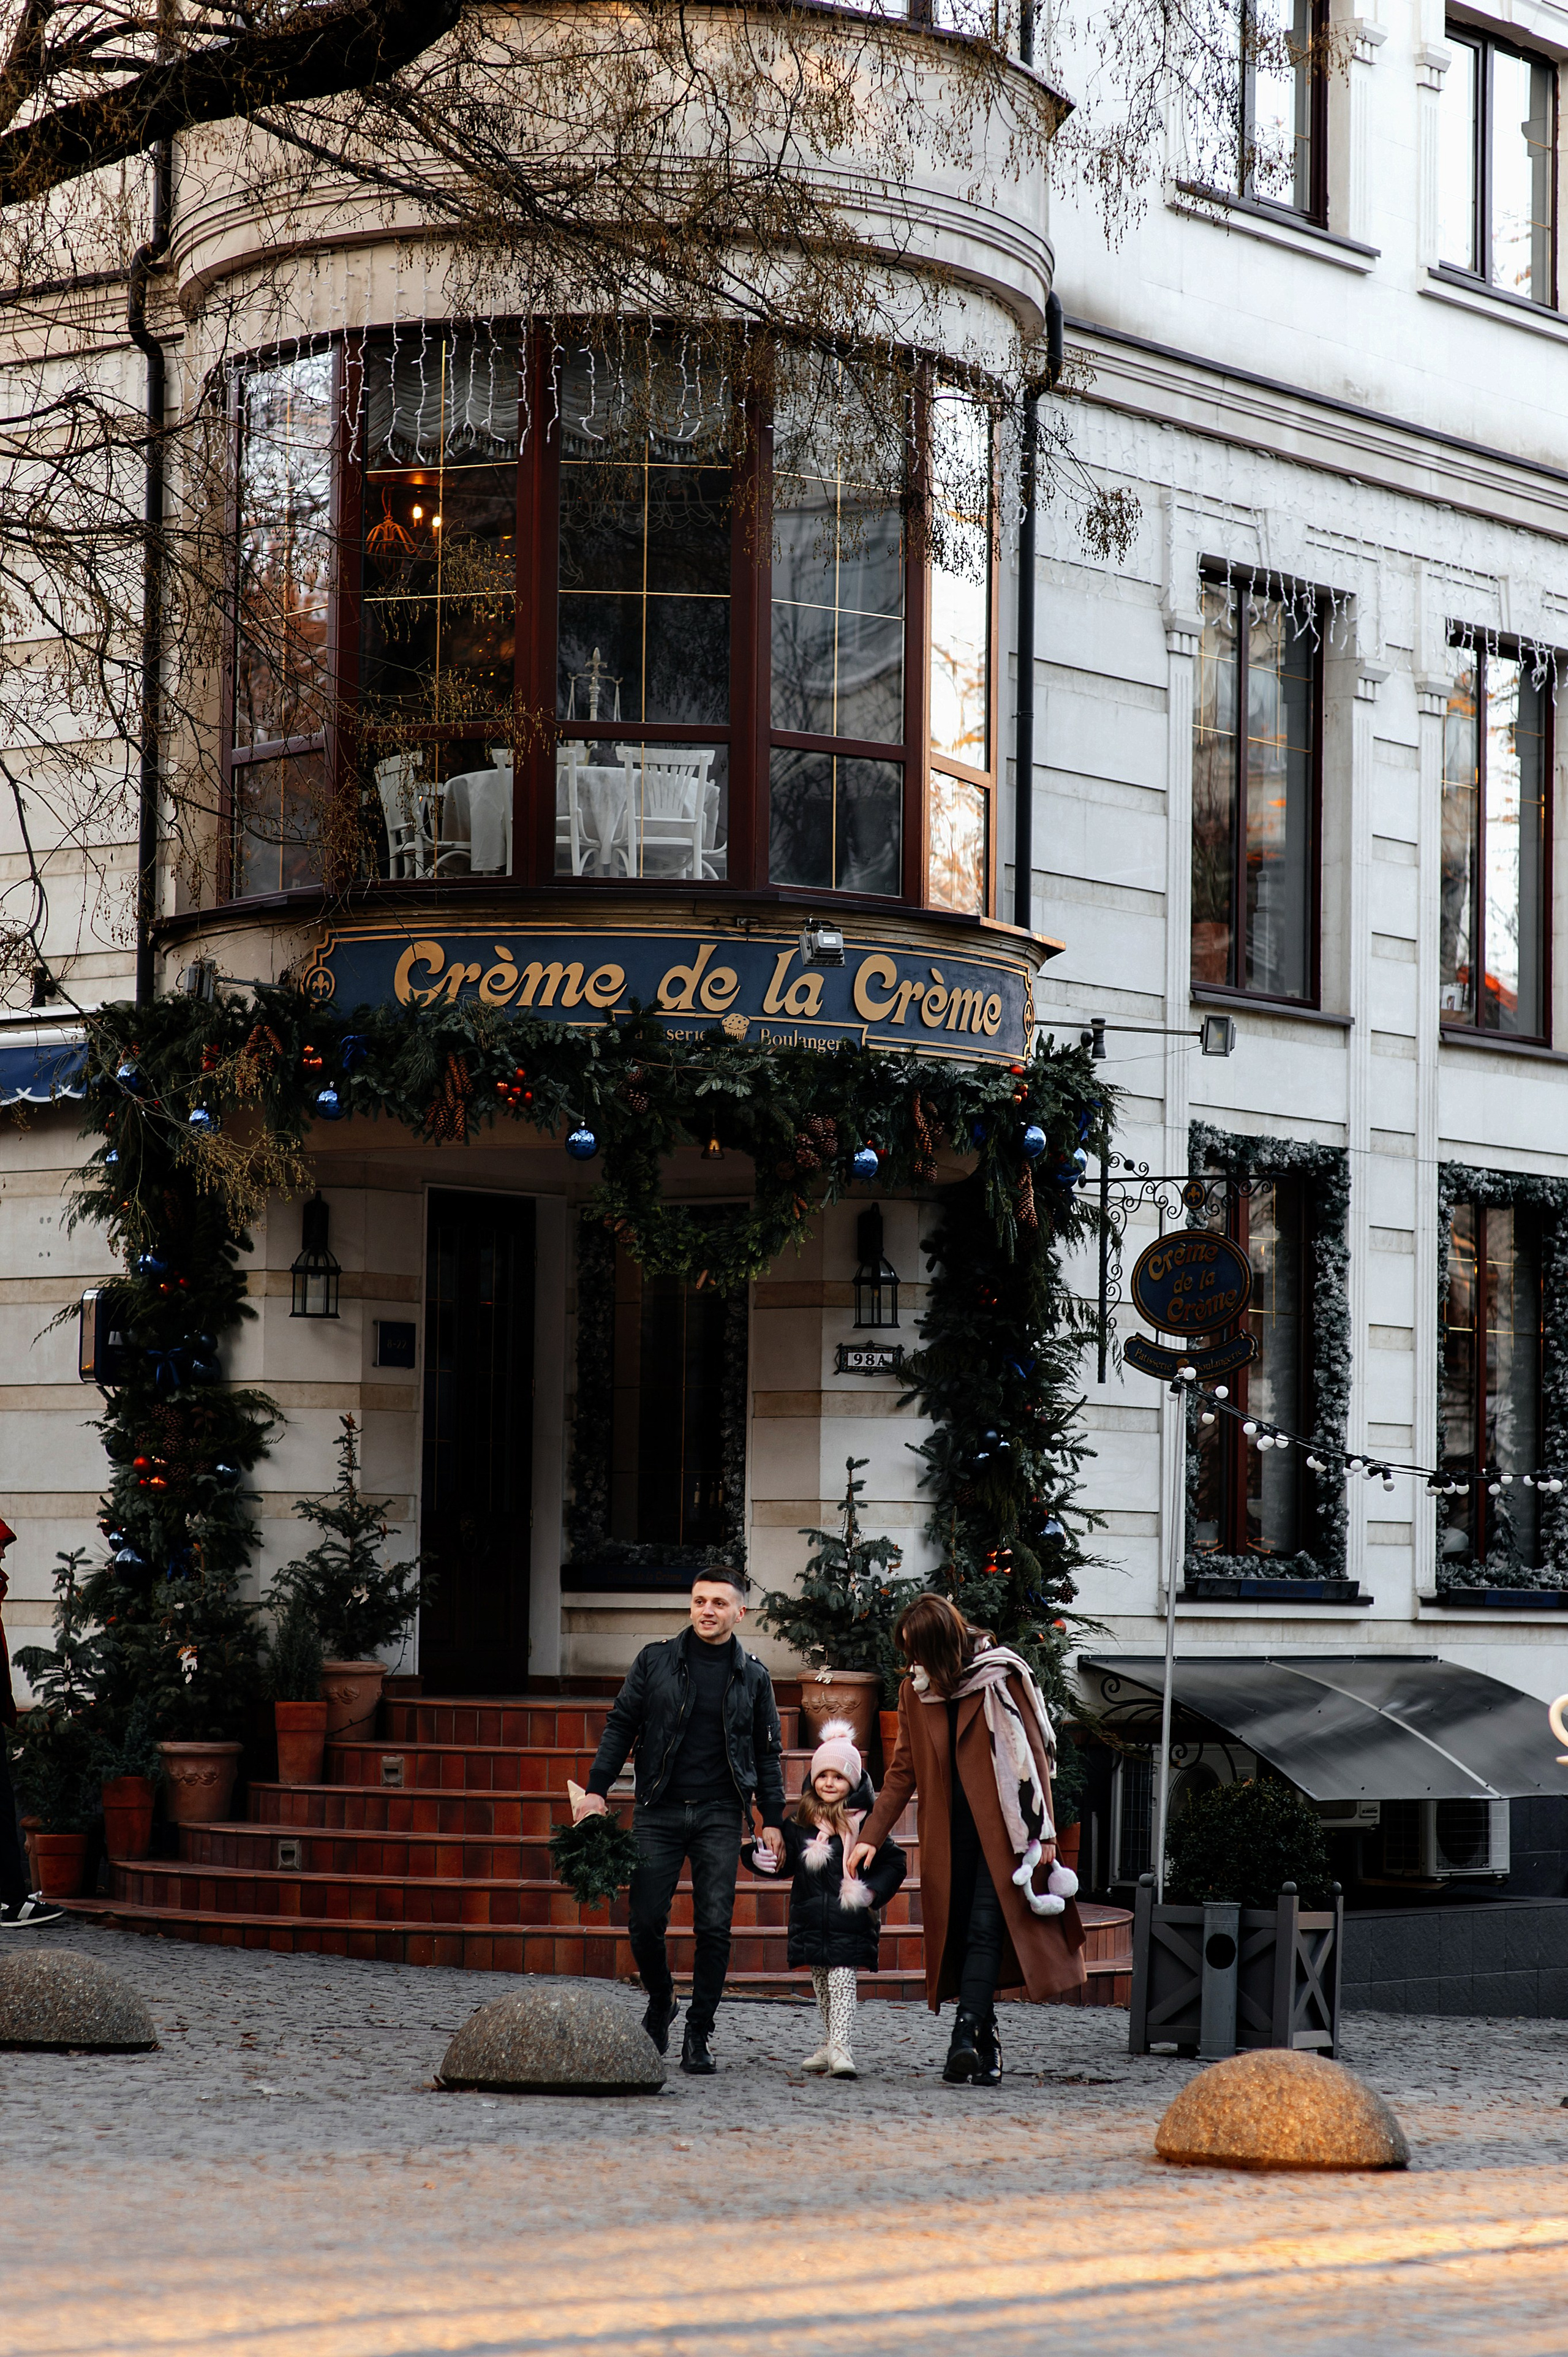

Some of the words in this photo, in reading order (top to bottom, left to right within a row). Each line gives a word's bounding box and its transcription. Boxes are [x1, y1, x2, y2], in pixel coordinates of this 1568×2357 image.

[394, 940, 628, 1008] Crème
[657, 944, 741, 1011] de
[763, 948, 825, 1017] la
[854, 954, 1002, 1036] Crème
[761, 1028, 844, 1053] Boulanger
[1148, 1242, 1219, 1281] Crème
[1173, 1271, 1193, 1294] de
[1199, 1270, 1215, 1291] la
[1167, 1289, 1237, 1322] Crème
[853, 1353, 887, 1366] 98A
[1194, 1348, 1243, 1372] Boulangerie
